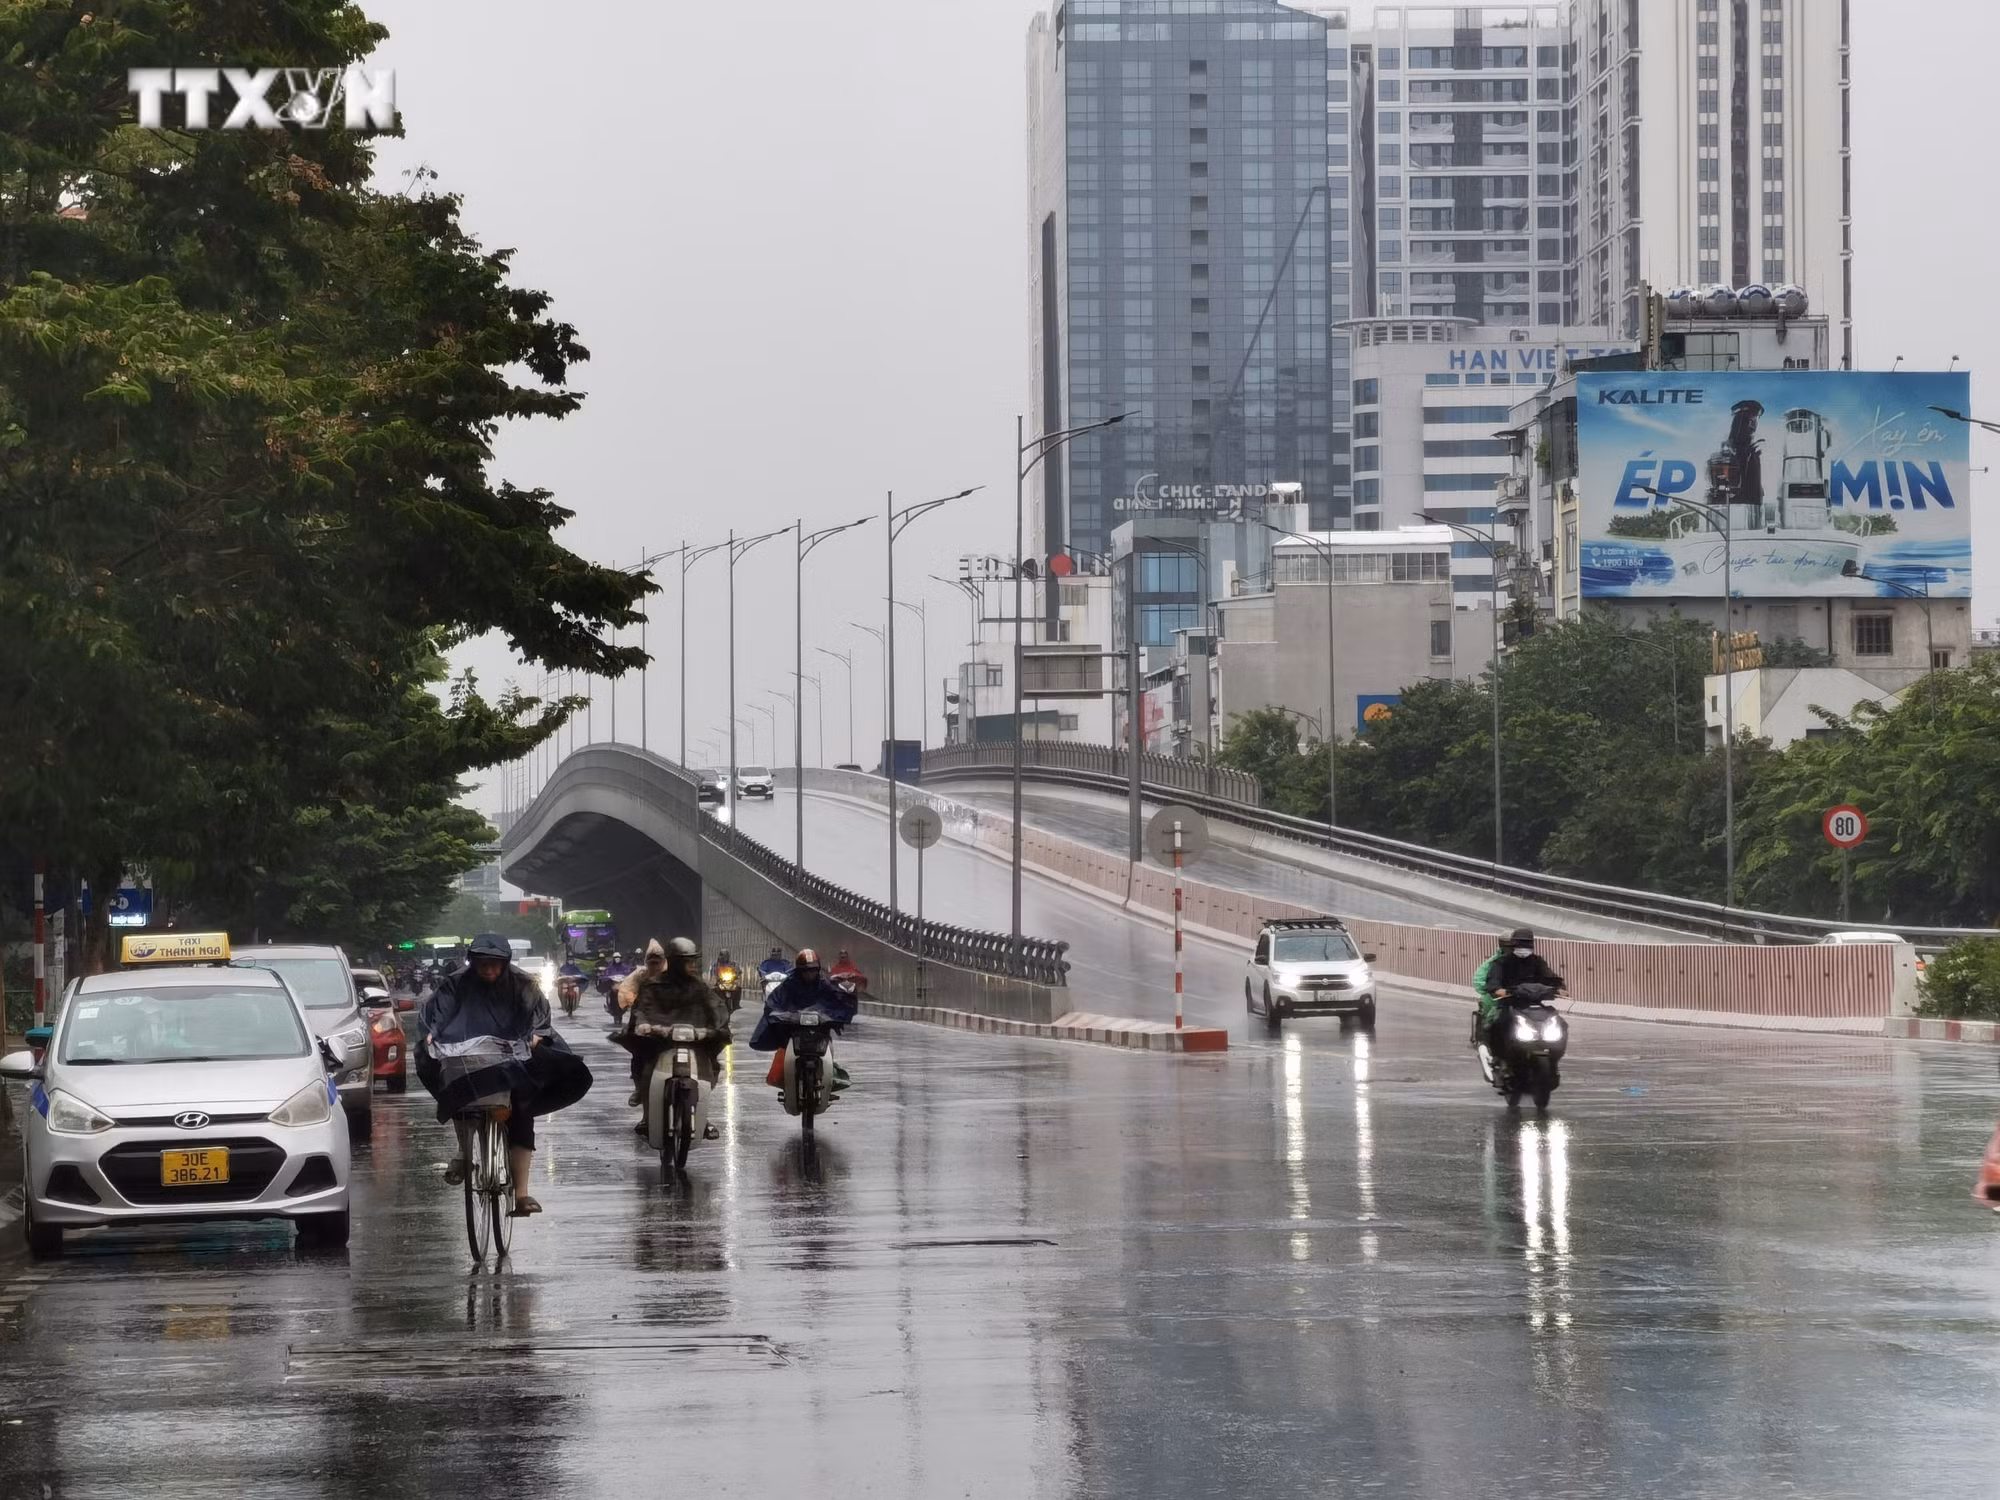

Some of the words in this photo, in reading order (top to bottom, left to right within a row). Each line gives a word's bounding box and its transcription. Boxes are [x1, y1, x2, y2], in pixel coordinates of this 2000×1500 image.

[1450, 349, 1507, 370] HAN
[1598, 389, 1704, 405] KALITE
[1613, 448, 1697, 508] ÉP
[1835, 817, 1854, 836] 80
[178, 937, 200, 946] TAXI
[159, 947, 195, 957] THANH
[199, 946, 221, 956] NGA
[181, 1152, 209, 1166] 30E
[170, 1167, 219, 1182] 386.21
